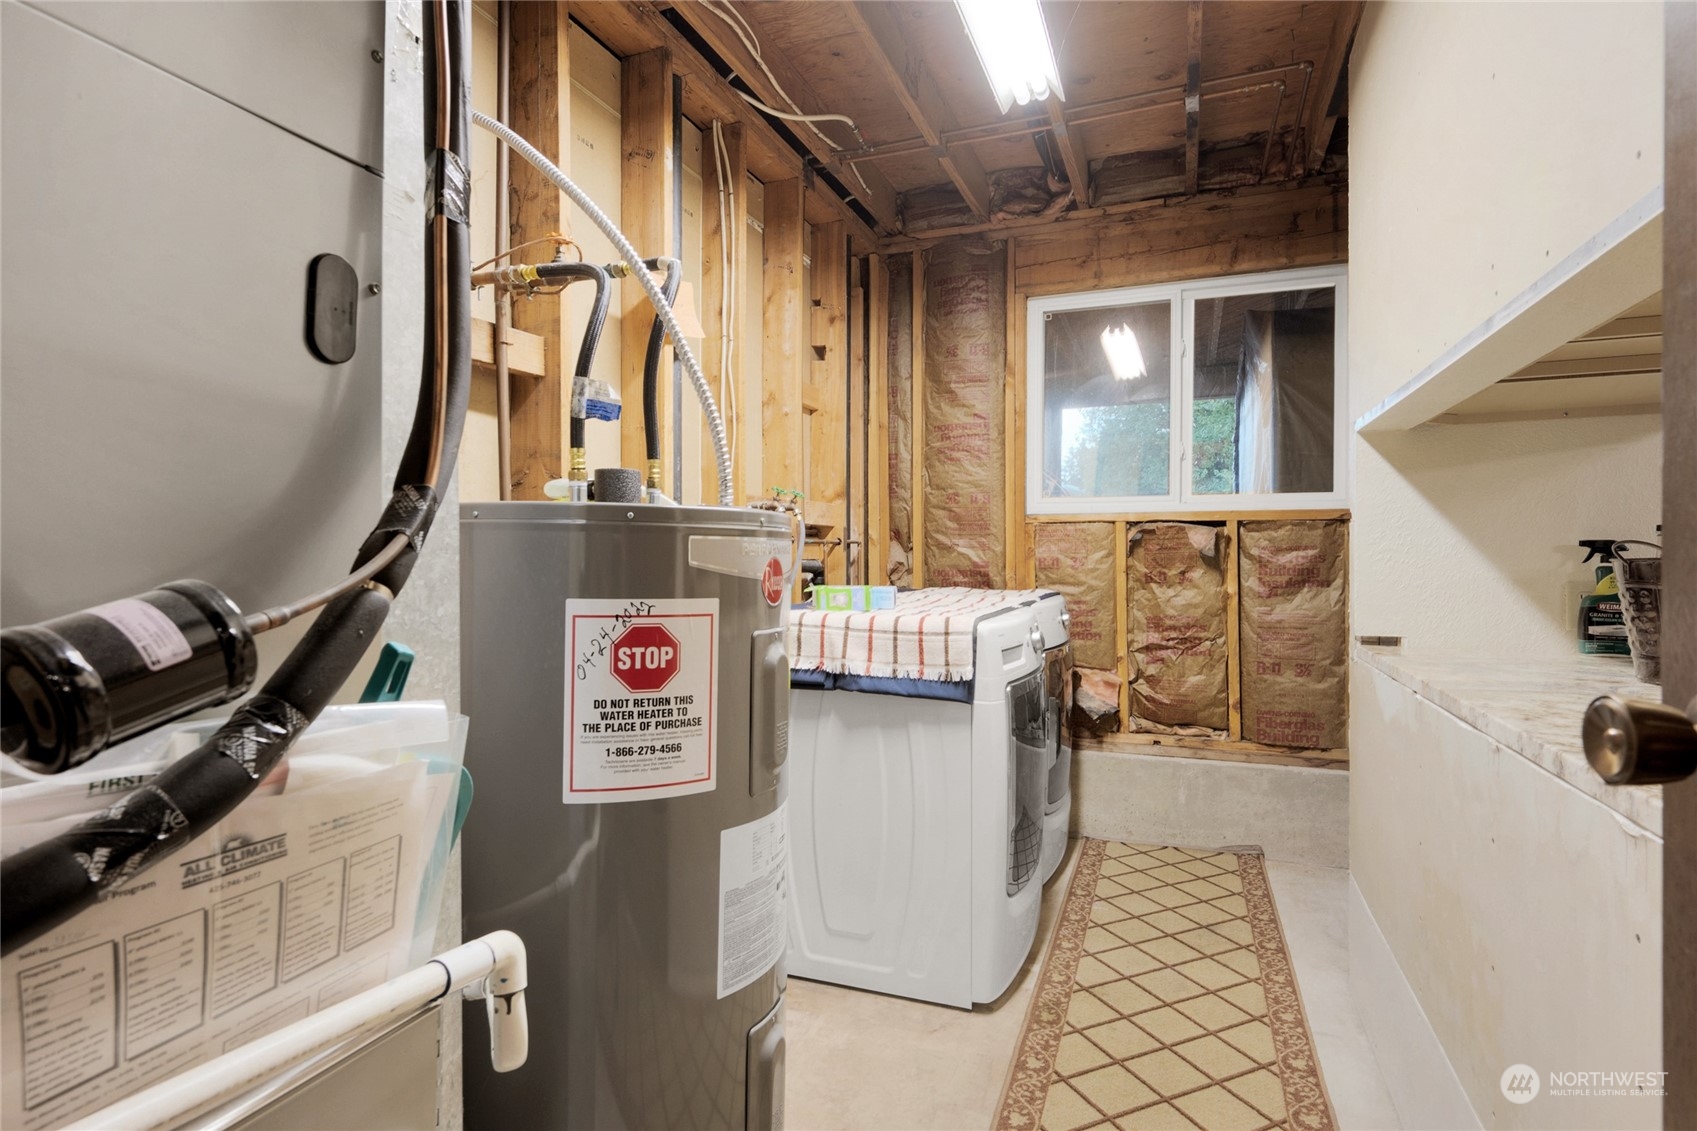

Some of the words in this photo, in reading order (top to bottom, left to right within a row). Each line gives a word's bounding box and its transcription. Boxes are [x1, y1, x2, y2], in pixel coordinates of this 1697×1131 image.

[617, 646, 674, 670] STOP
[1256, 661, 1282, 675] R-11
[593, 699, 607, 710] DO
[610, 698, 630, 709] NOT
[633, 696, 671, 708] RETURN
[674, 695, 694, 706] THIS
[600, 710, 634, 720] WATER
[637, 708, 674, 720] HEATER
[676, 706, 688, 716] TO
[582, 724, 602, 733] THE
[604, 722, 636, 732] PLACE
[640, 721, 652, 731] OF
[655, 716, 702, 730] PURCHASE
[1256, 716, 1326, 732] Fiberglas
[1256, 729, 1320, 746] Building
[605, 742, 682, 758] 1-866-279-4566
[183, 860, 216, 878] ALL
[220, 838, 286, 867] CLIMATE
[112, 880, 157, 898] Program
